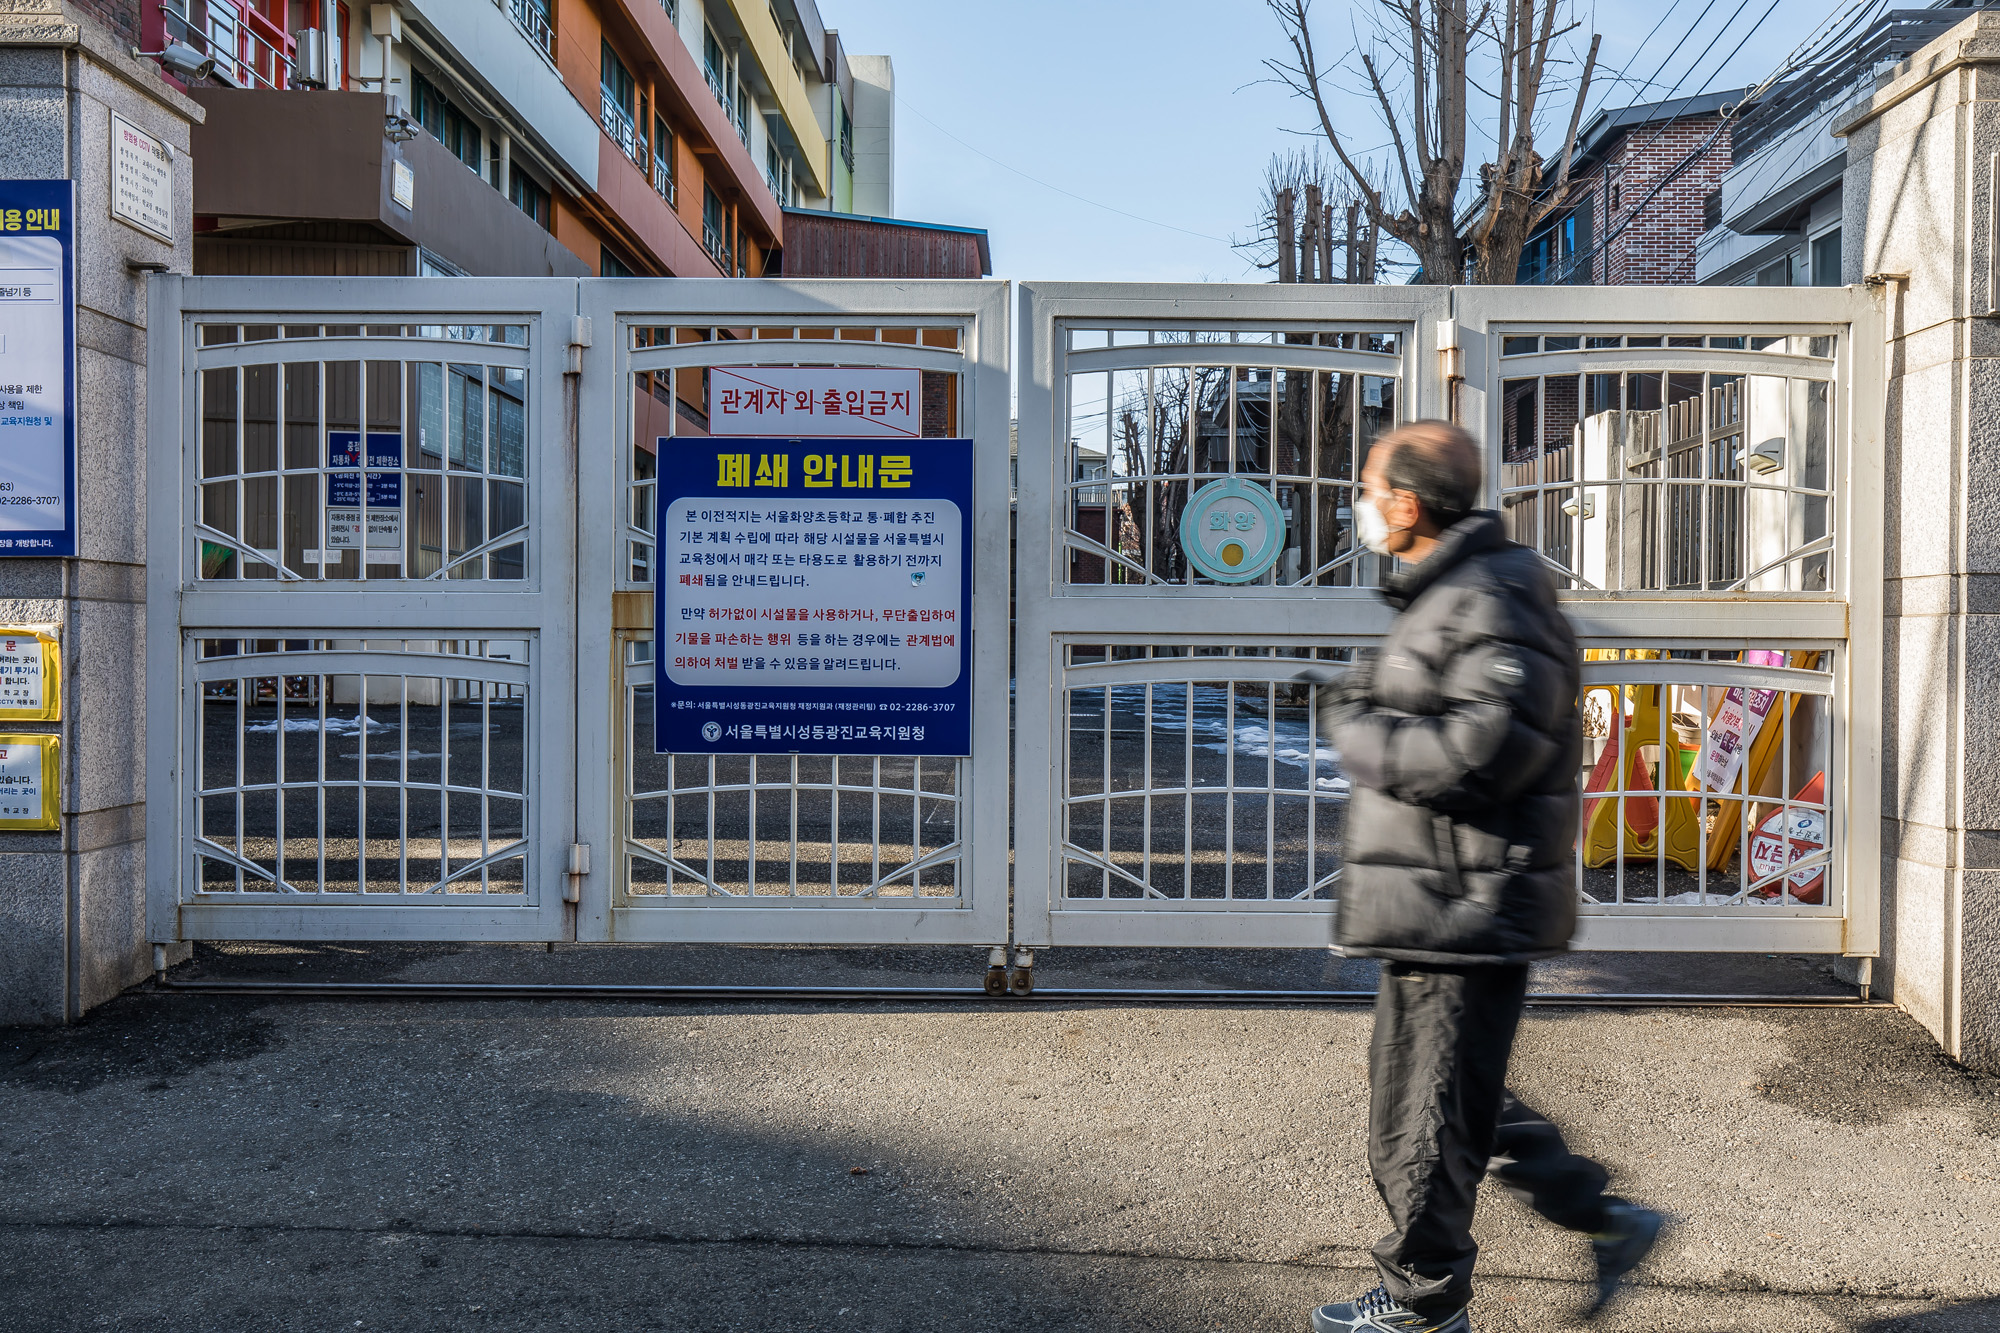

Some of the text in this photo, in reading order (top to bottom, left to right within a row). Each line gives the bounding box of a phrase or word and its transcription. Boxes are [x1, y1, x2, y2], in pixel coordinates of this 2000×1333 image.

[0, 208, 60, 231] 용 안내
[23, 288, 32, 297] 등
[0, 384, 42, 394] 사용을 제한
[8, 400, 24, 410] 책임
[721, 389, 911, 416] 관계자 외 출입금지
[1, 416, 52, 426] 교육지원청 및
[332, 454, 350, 466] 자동차
[717, 454, 913, 488] 폐쇄 안내문
[0, 496, 60, 506] 2-2286-3707)
[686, 511, 935, 524] 본 이전적지는 서울화양초등학교 통·폐합 추진
[1208, 510, 1256, 532] 화양
[15, 539, 54, 548] 개방합니다.
[679, 531, 945, 546] 기본 계획 수립에 따라 해당 시설물을 서울특별시
[679, 553, 942, 567] 교육청에서 매각 또는 타용도로 활용하기 전까지
[679, 574, 810, 587] 폐쇄됨을 안내드립니다.
[681, 608, 956, 623] 만약 허가없이 시설물을 사용하거나, 무단출입하여
[6, 640, 16, 652] 문
[675, 633, 955, 647] 기물을 파손하는 행위 등을 하는 경우에는 관계법에
[22, 656, 38, 664] 곳이
[675, 657, 900, 671] 의하여 처벌 받을 수 있음을 알려드립니다.
[14, 666, 38, 674] 투기시
[6, 677, 30, 685] 합니다.
[671, 701, 956, 712] ※문의: 서울특별시성동광진교육지원청 재정지원과 (재정관리팀) 02-2286-3707
[725, 724, 925, 741] 서울특별시성동광진교육지원청
[22, 788, 36, 796] 곳이
